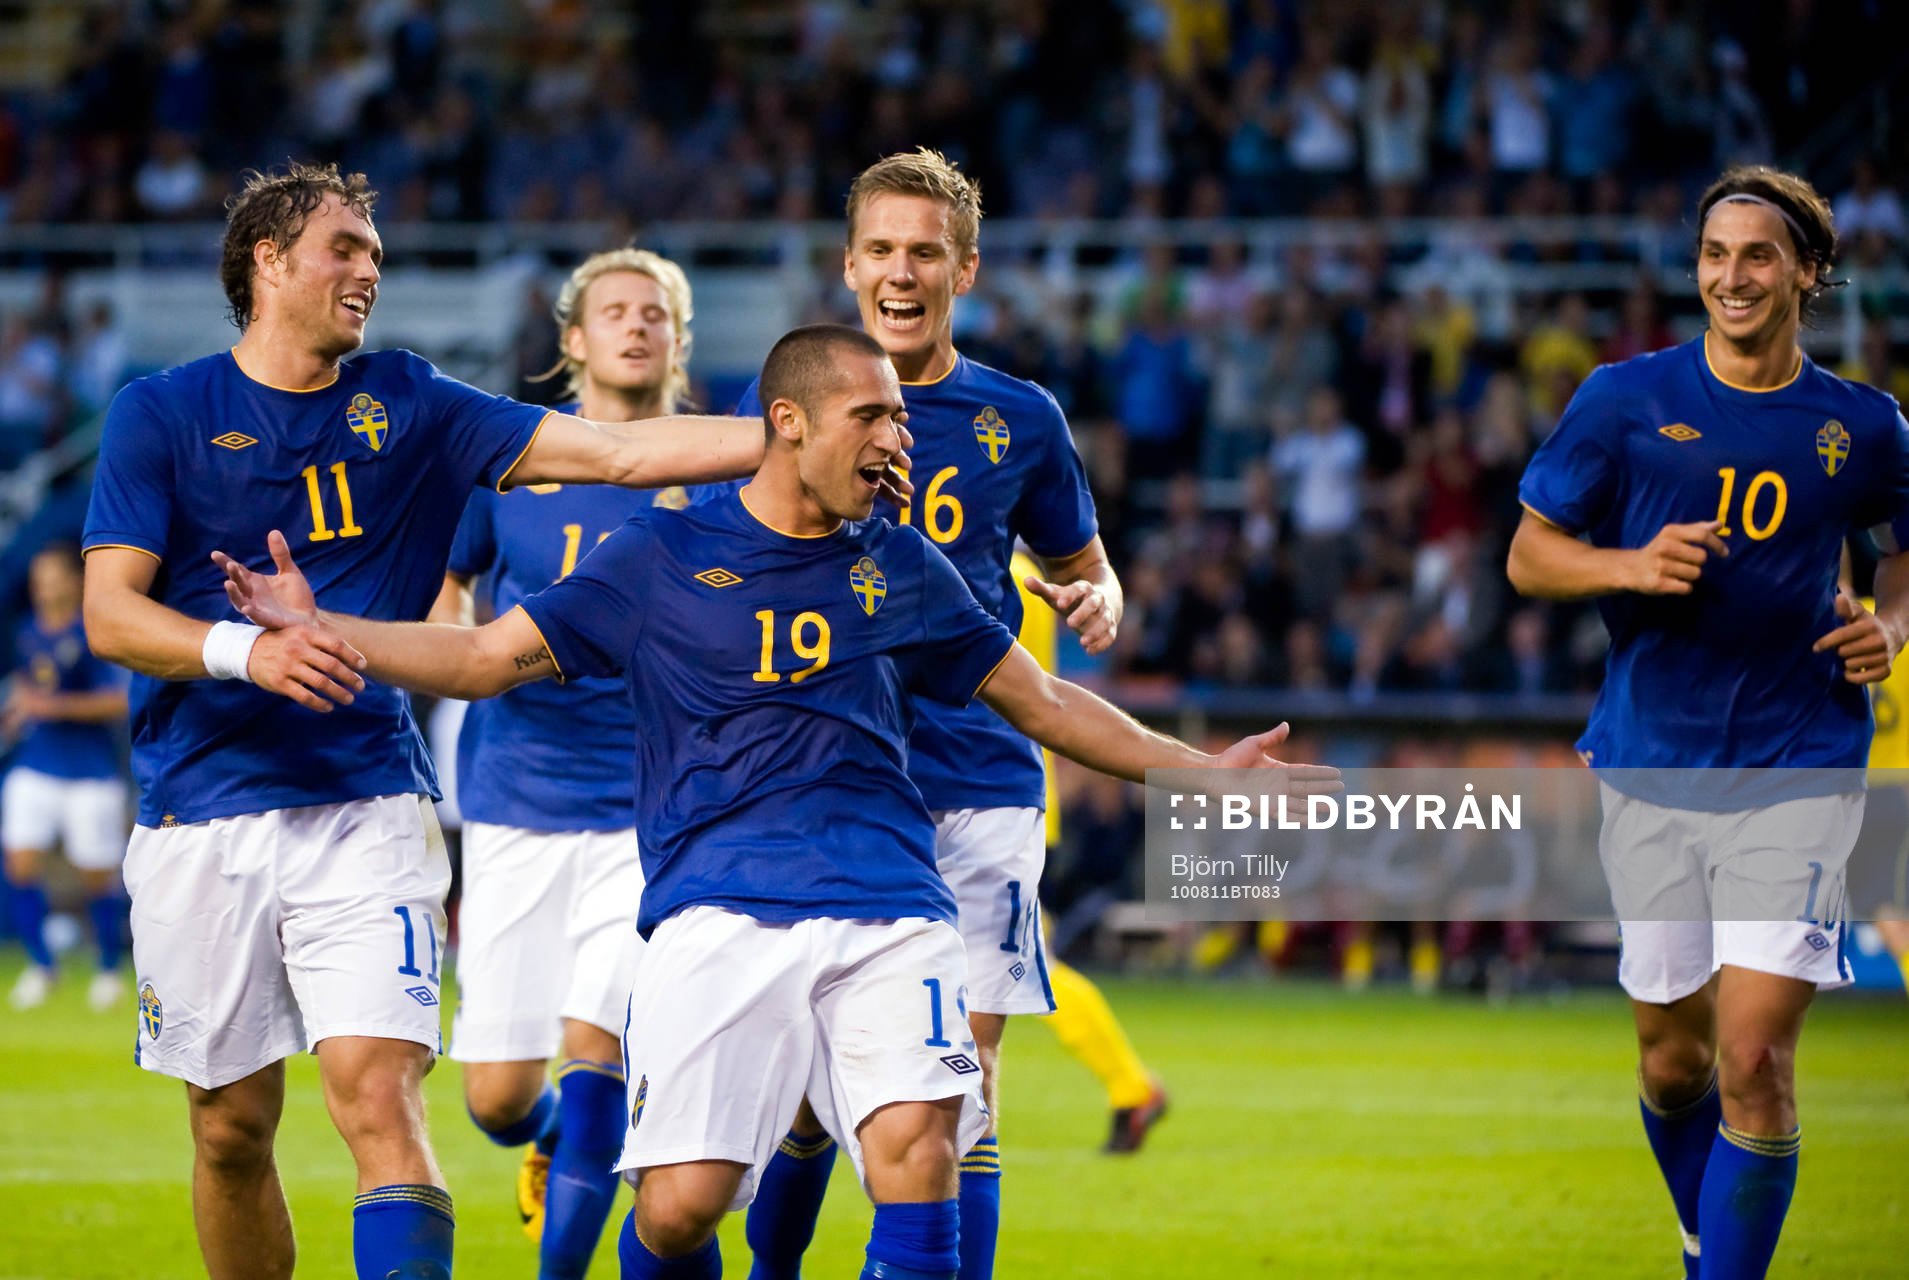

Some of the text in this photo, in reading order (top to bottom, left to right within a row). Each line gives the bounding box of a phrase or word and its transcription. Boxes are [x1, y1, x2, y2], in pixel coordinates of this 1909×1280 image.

[301, 461, 363, 541] 11
[1716, 467, 1788, 541] 10
[553, 523, 611, 585] 1
[752, 609, 831, 683] 19
[394, 906, 439, 985] 11
